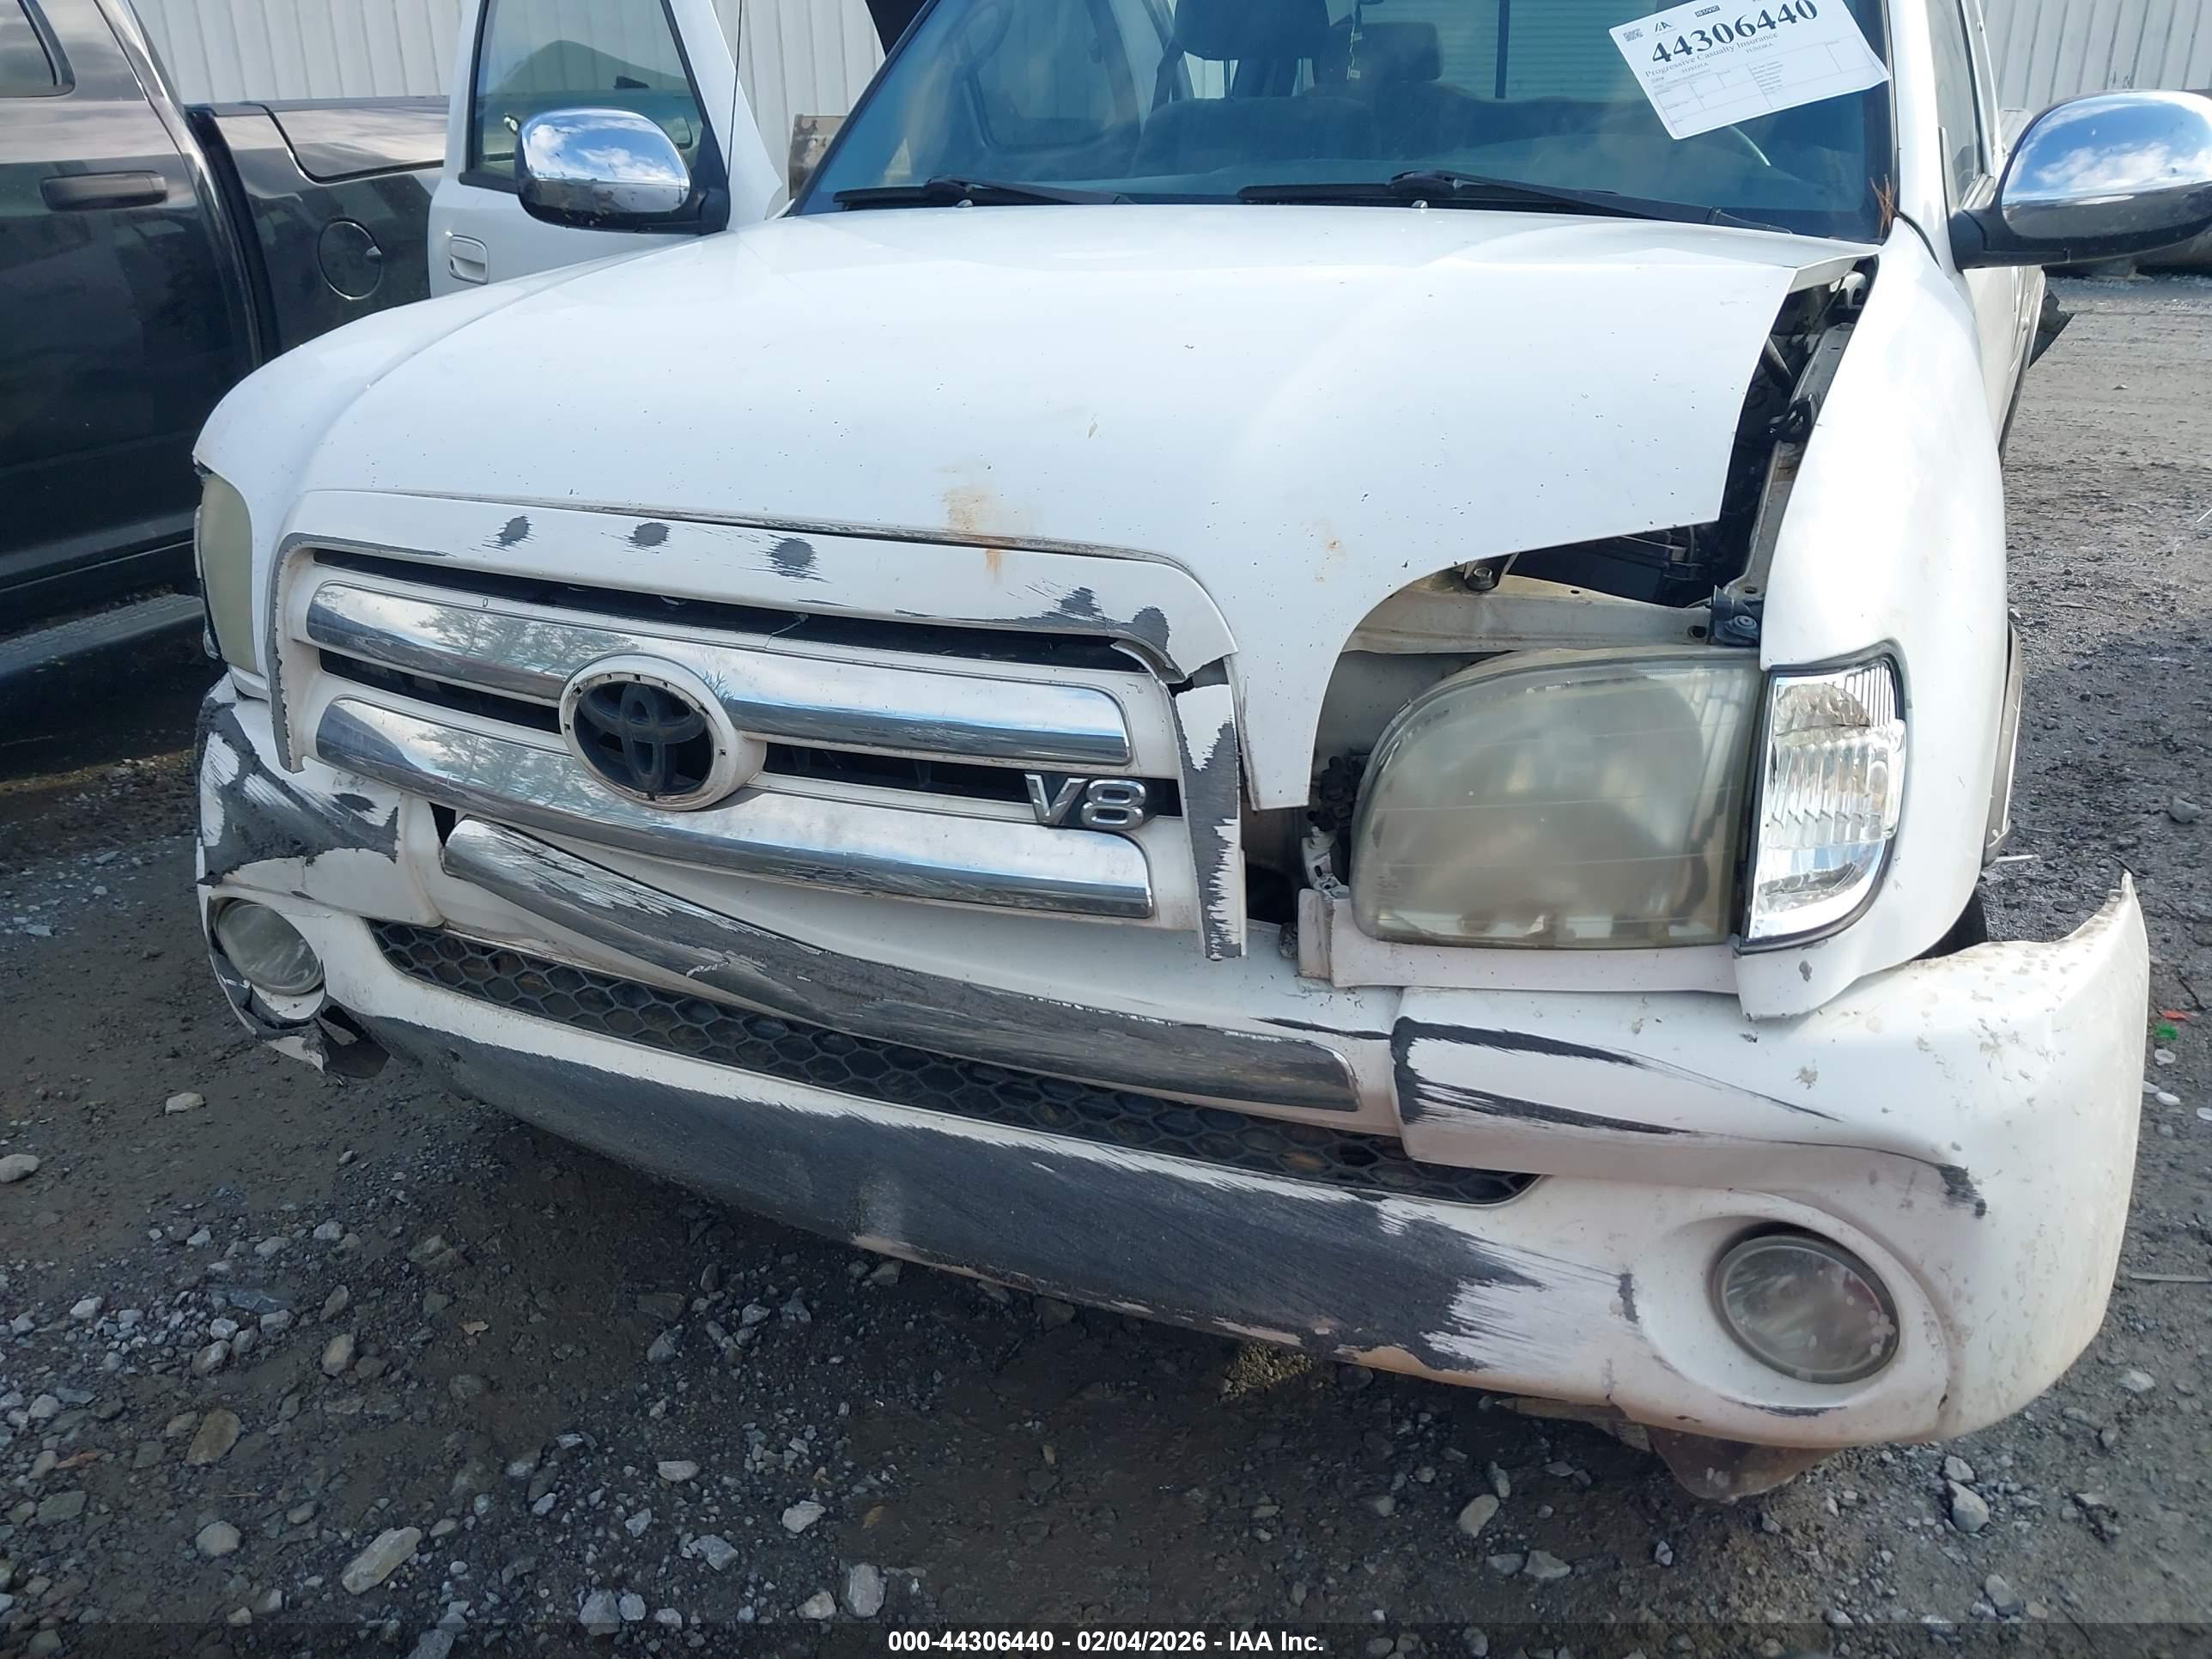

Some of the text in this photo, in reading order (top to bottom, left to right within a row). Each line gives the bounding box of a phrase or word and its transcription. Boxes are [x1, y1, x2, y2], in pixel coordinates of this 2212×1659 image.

[1645, 32, 1778, 78] Progressive Casualty Insurance
[1652, 0, 1818, 63] 44306440
[1024, 773, 1147, 831] V8
